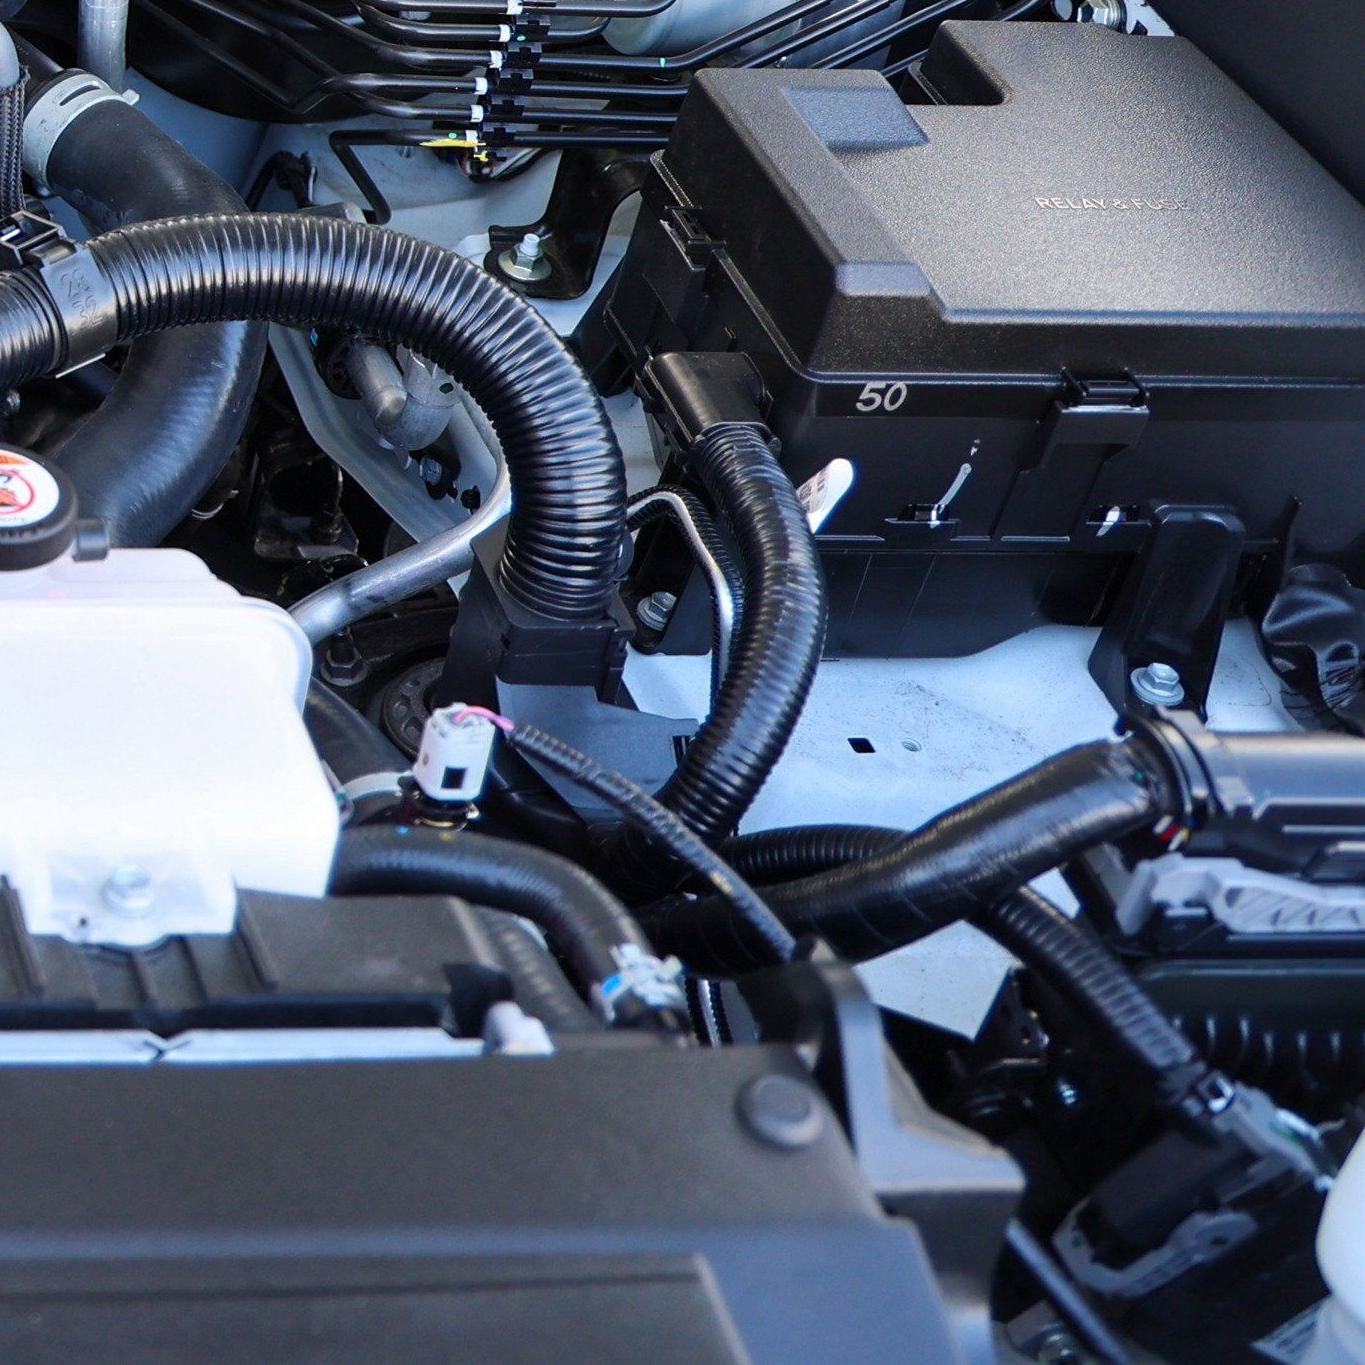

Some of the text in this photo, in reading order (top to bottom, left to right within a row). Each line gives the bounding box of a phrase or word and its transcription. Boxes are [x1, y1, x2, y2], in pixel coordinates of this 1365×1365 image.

[1034, 197, 1191, 210] RELAY & FUSE
[855, 381, 908, 412] 50
